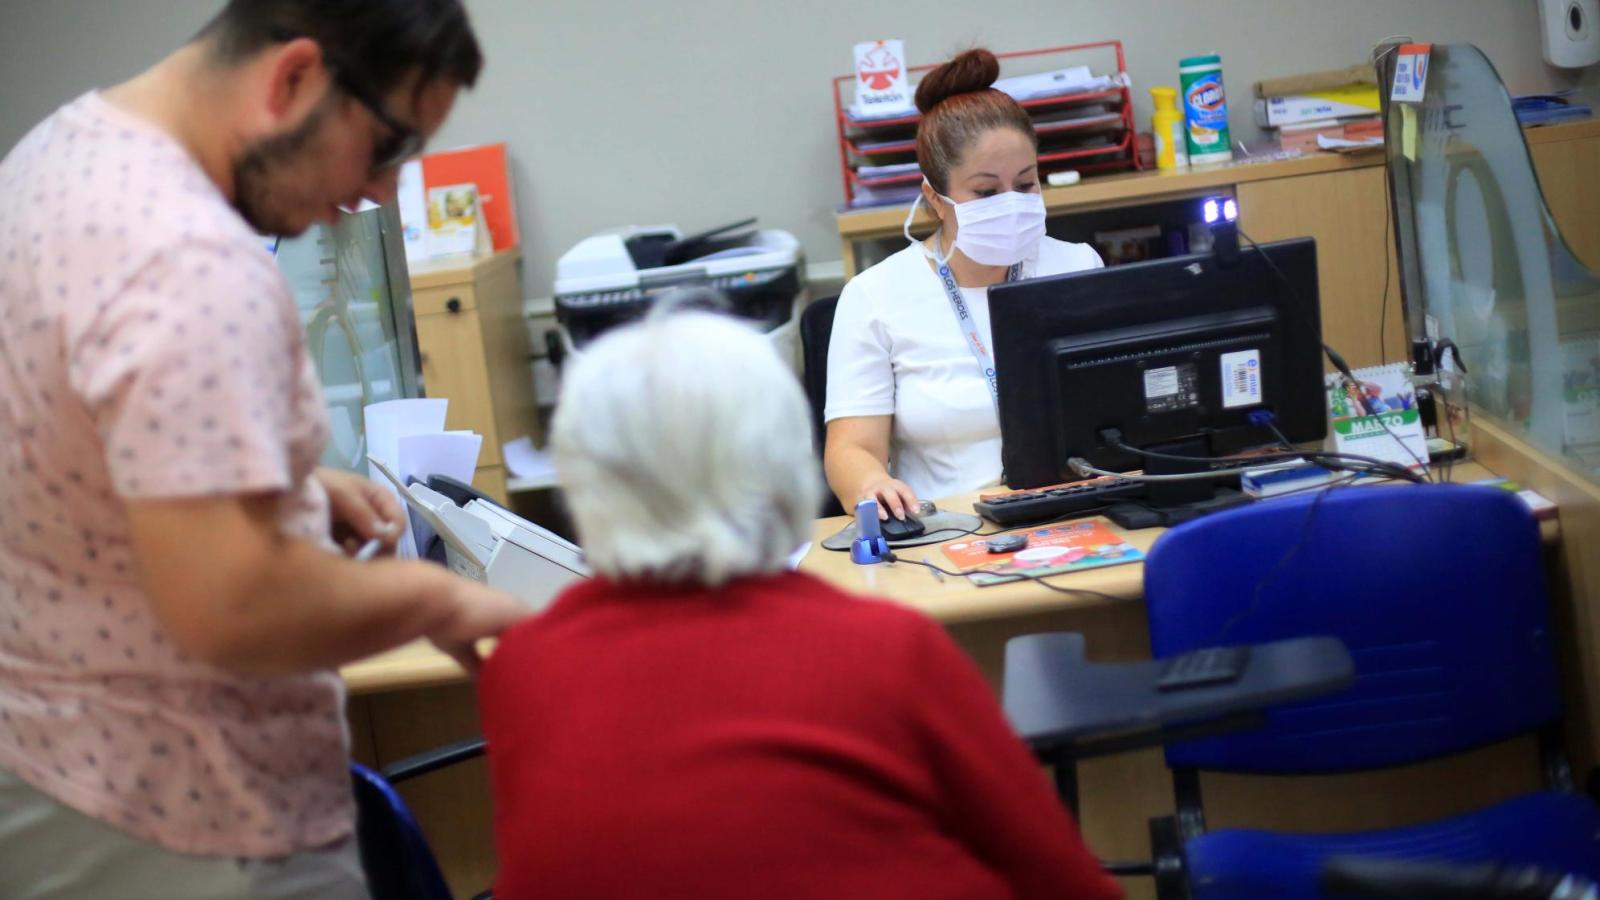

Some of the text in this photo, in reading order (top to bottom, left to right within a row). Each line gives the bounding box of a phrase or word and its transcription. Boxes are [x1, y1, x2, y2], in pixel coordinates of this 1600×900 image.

[943, 275, 968, 320] LOS HEROES
[1351, 415, 1403, 434] MARZO
